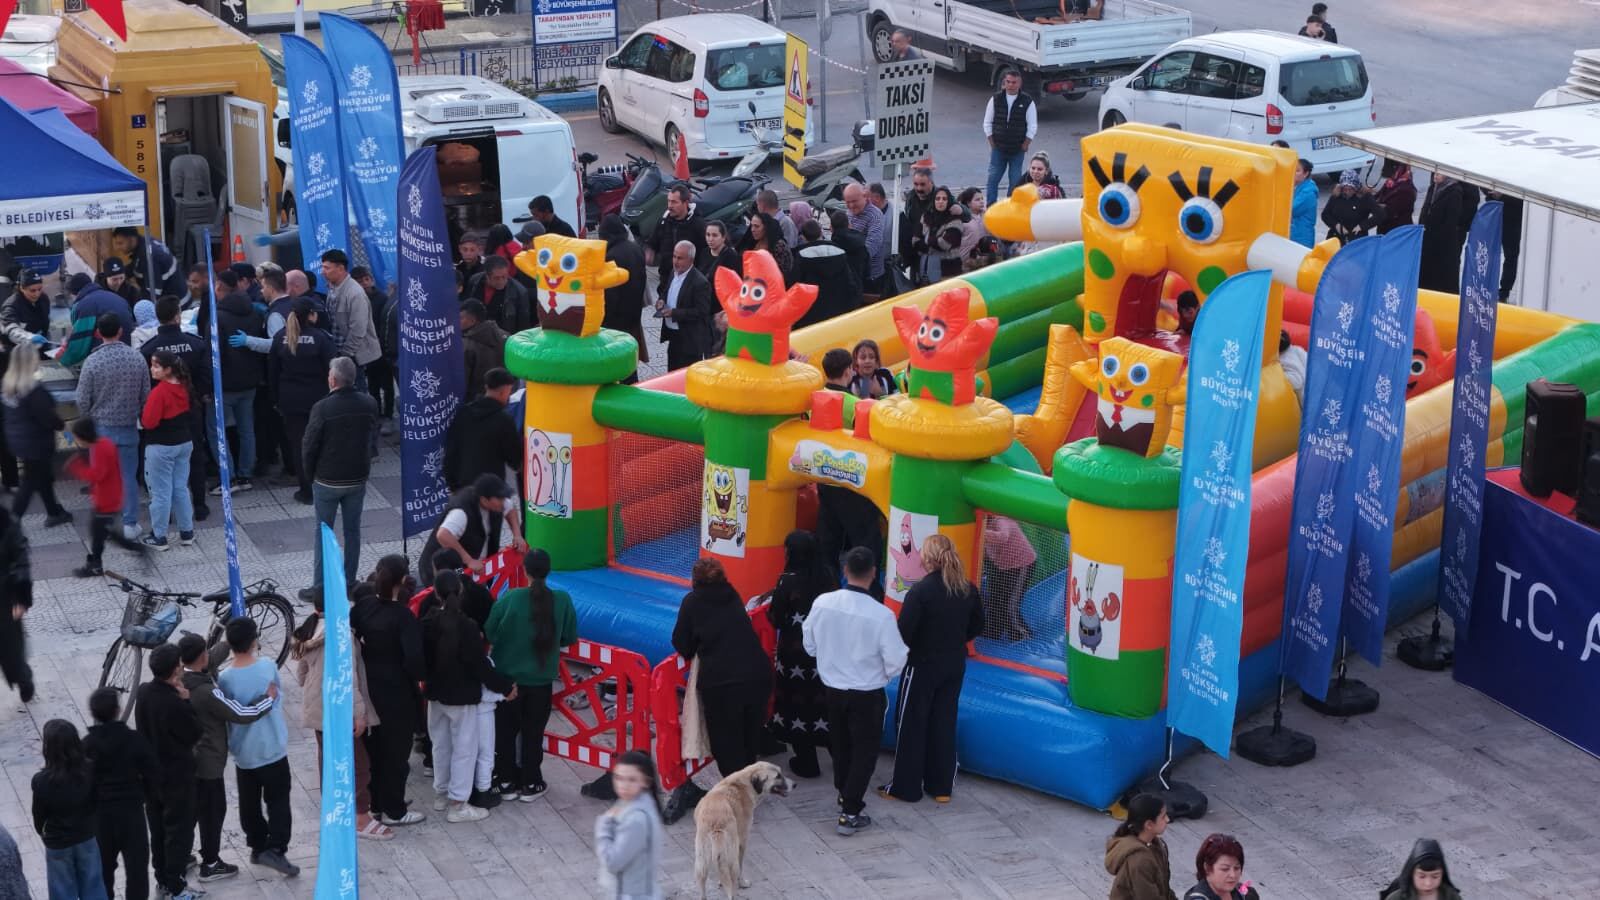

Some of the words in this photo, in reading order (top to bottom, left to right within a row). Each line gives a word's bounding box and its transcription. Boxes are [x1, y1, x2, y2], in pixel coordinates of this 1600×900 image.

[886, 77, 925, 108] TAKSİ
[879, 108, 930, 139] DURAĞI
[6, 208, 74, 225] BELEDİYESİ
[400, 228, 444, 253] BÜYÜKŞEHİR
[412, 223, 434, 239] AYDIN
[401, 245, 442, 268] BELEDİYESİ
[414, 317, 447, 329] AYDIN
[424, 391, 454, 414] AYDIN
[1496, 561, 1564, 651] T.C.
